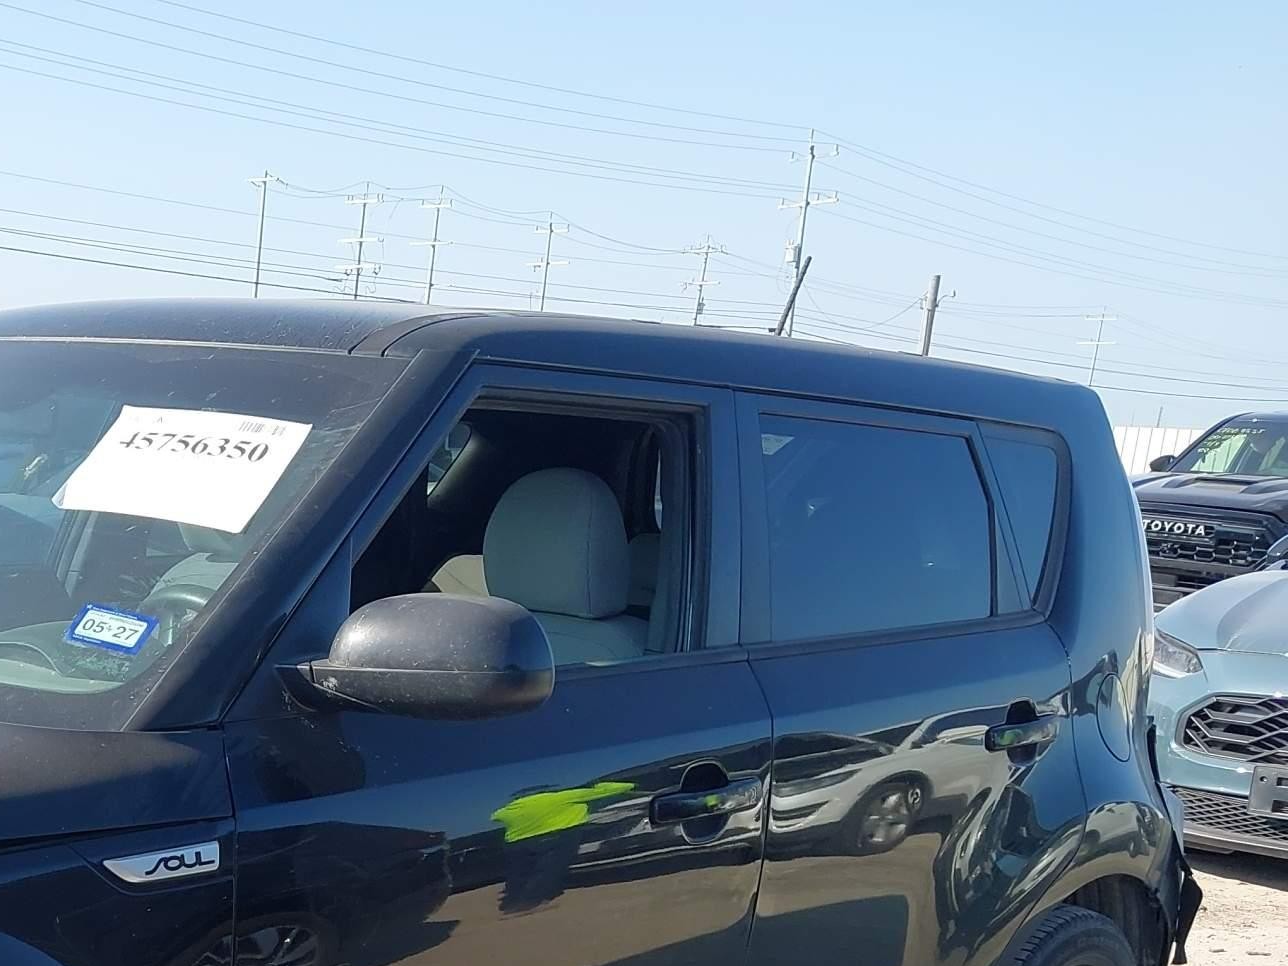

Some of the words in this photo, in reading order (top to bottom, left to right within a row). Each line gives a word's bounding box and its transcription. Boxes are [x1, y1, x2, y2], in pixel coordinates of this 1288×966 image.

[119, 431, 270, 463] 45756350
[1142, 519, 1206, 537] TOYOTA
[82, 618, 105, 633] 05
[112, 626, 139, 641] 27
[144, 850, 216, 876] SOUL
